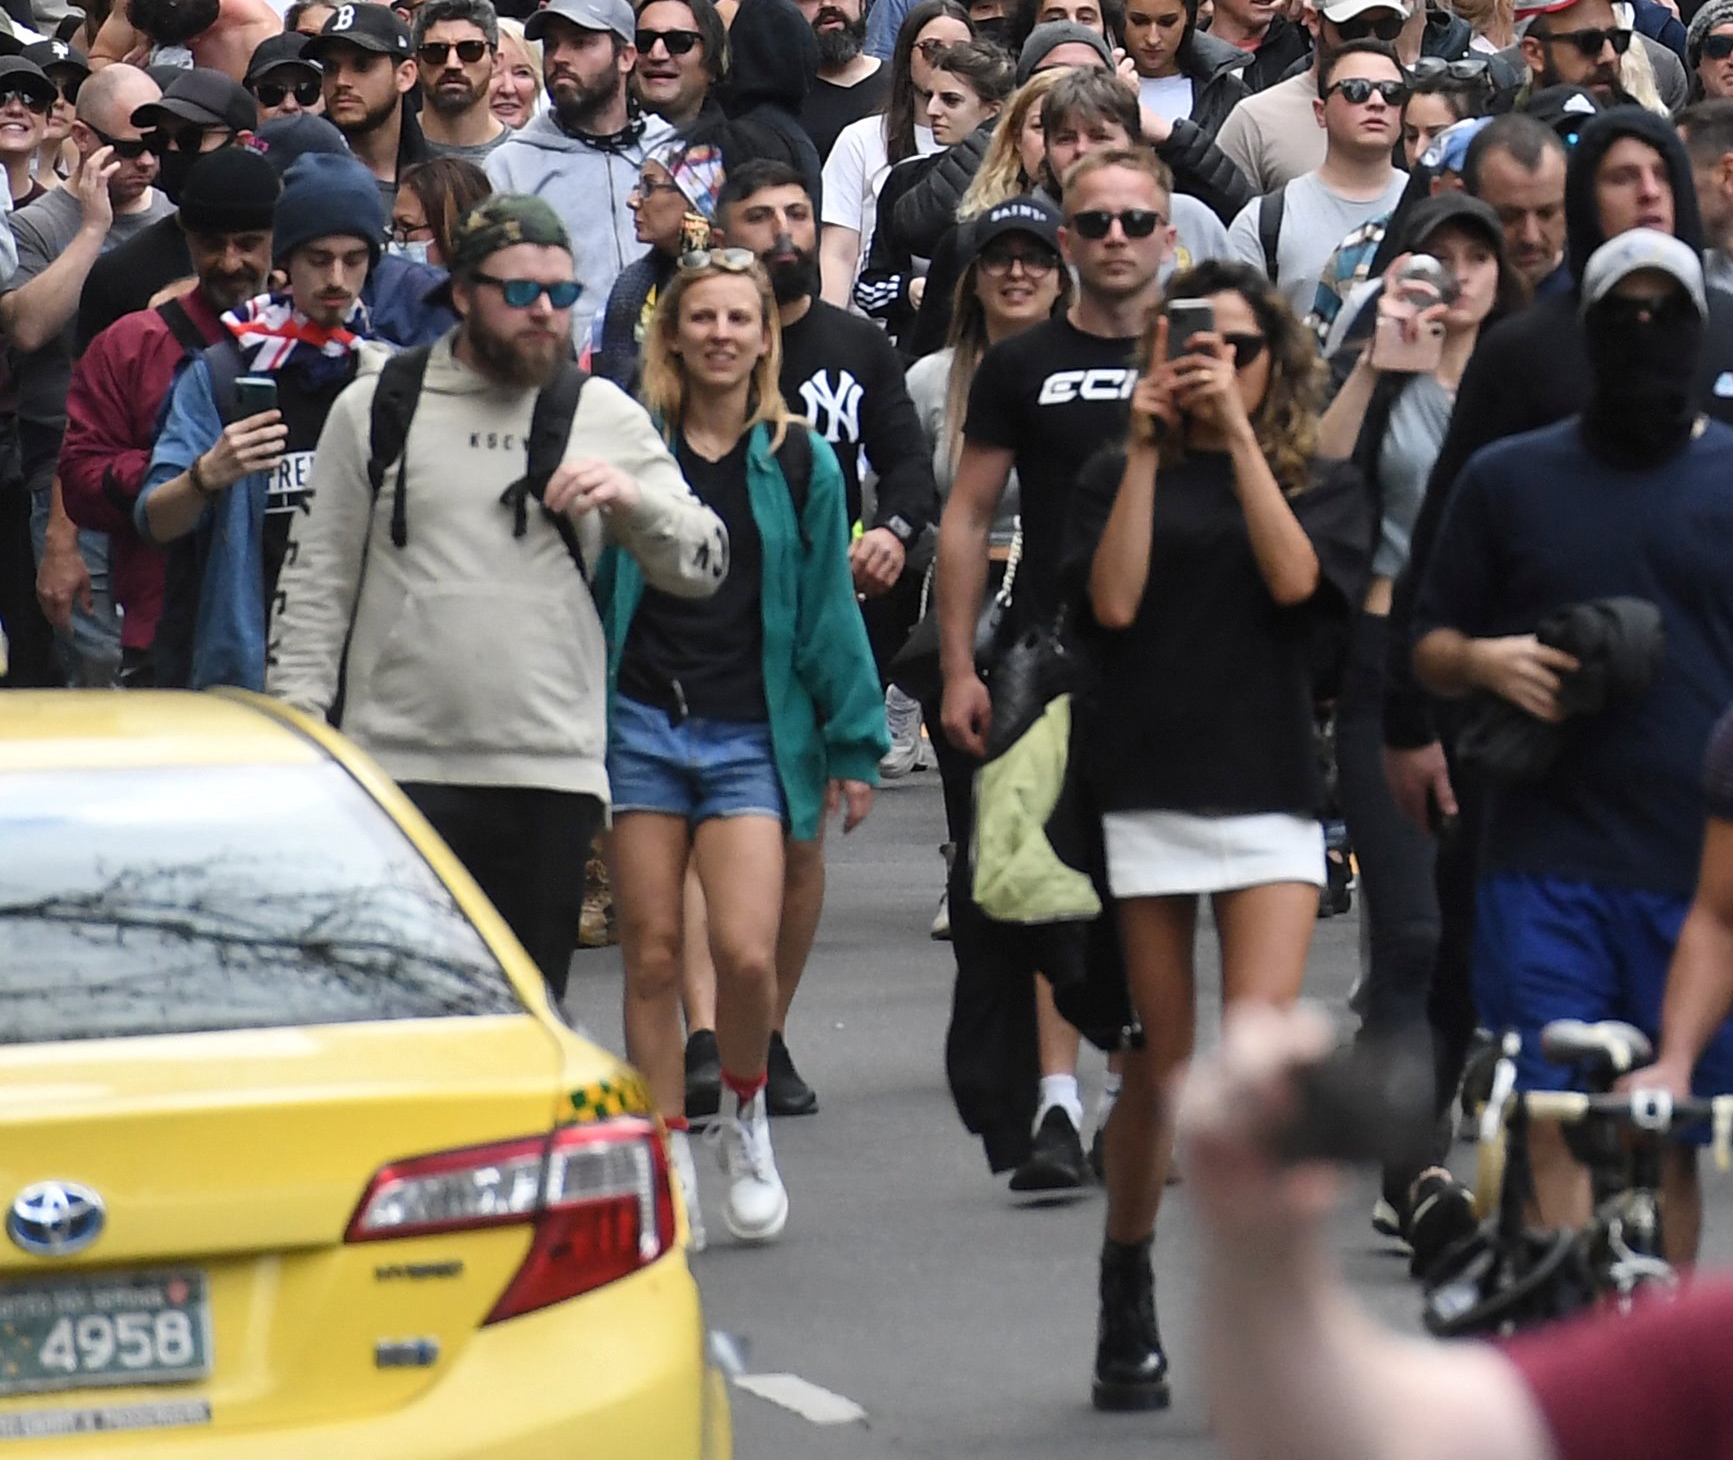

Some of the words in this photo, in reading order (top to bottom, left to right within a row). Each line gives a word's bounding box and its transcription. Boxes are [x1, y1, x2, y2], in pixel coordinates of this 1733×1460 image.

[333, 4, 355, 31] B
[799, 368, 864, 442] NY
[39, 1309, 194, 1372] 4958
